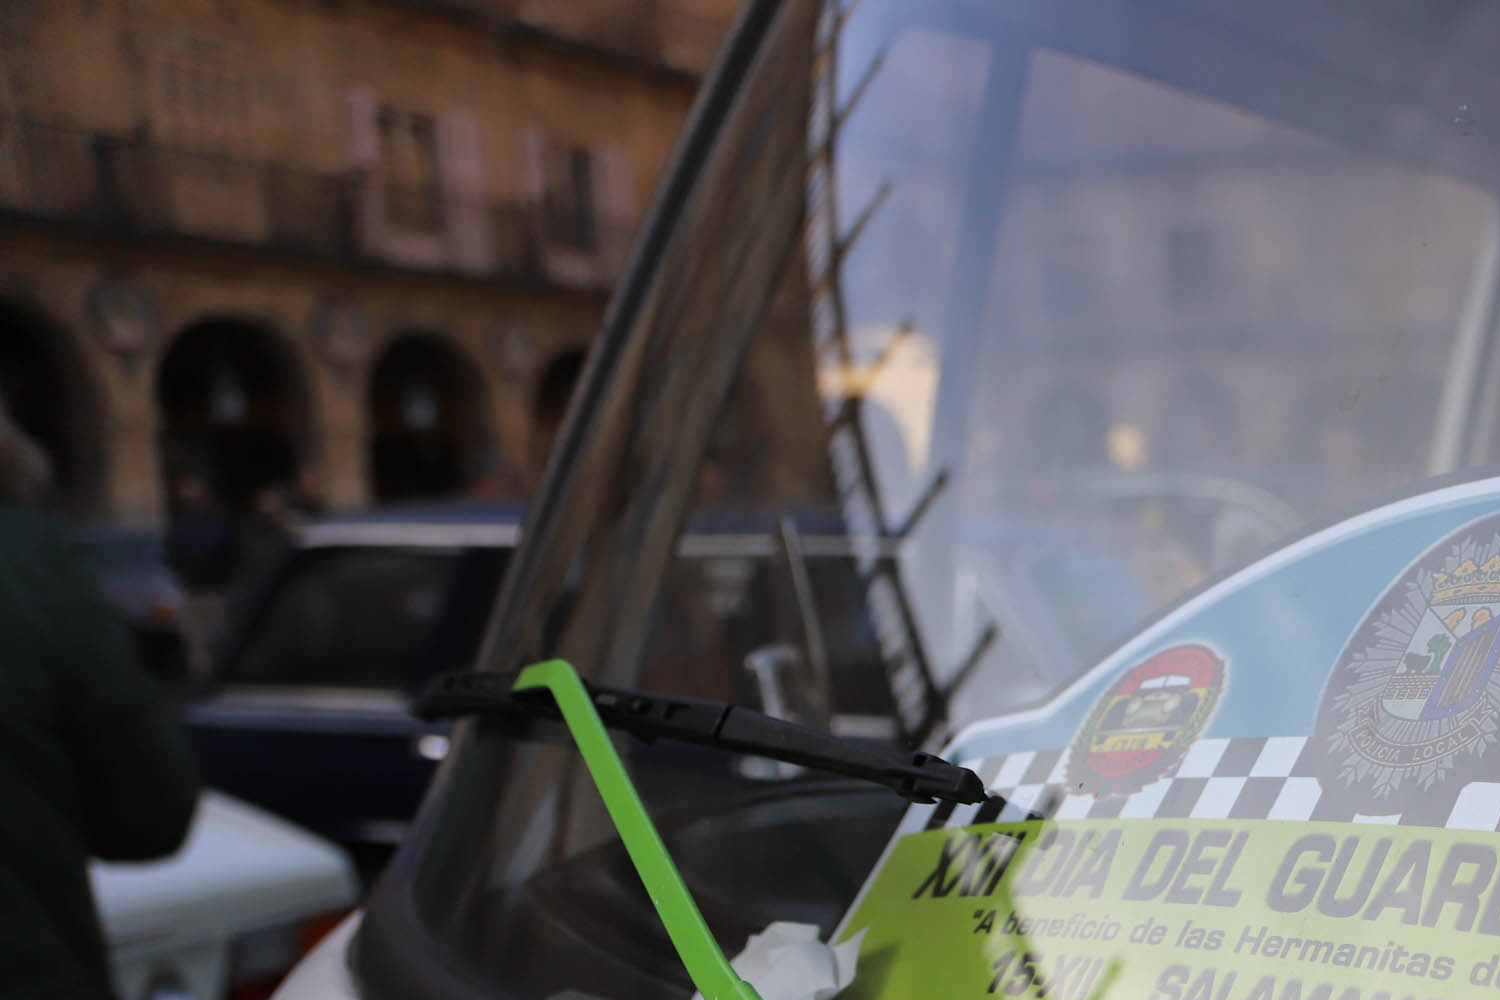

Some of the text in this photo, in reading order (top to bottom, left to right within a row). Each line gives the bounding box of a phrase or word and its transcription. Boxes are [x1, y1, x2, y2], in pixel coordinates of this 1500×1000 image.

[1355, 729, 1470, 761] POLICIA LOCAL
[1011, 828, 1124, 898] DIA
[1123, 829, 1252, 908] DEL
[1002, 911, 1121, 941] beneficio
[1129, 912, 1169, 945] de
[1175, 920, 1226, 951] las
[1233, 925, 1455, 981] Hermanitas
